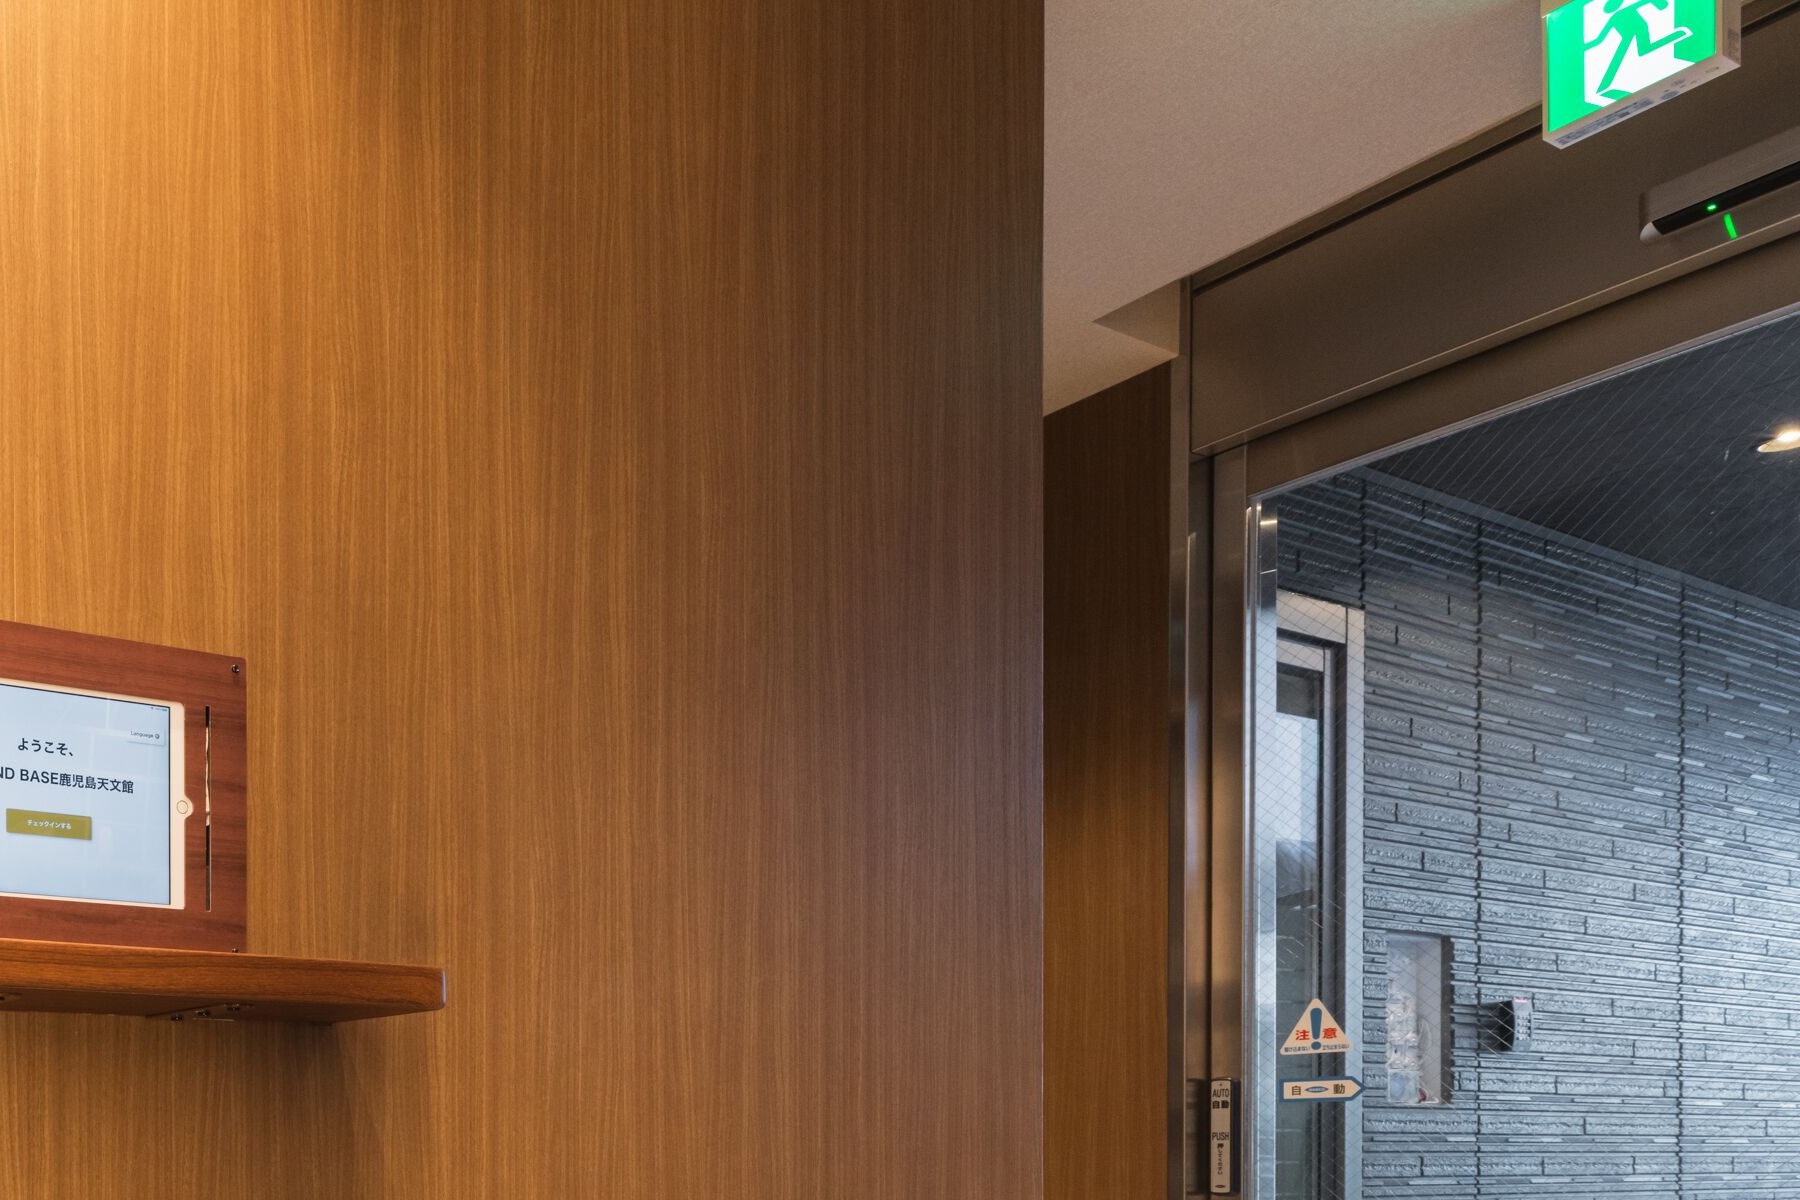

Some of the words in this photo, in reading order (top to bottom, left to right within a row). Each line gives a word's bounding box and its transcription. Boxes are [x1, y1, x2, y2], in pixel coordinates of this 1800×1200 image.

[130, 731, 154, 739] Language
[17, 738, 74, 757] ようこそ、
[20, 769, 134, 794] BASE鹿児島天文館
[26, 819, 72, 830] チェックインする
[1212, 1089, 1229, 1098] AUTO
[1212, 1132, 1229, 1141] PUSH
